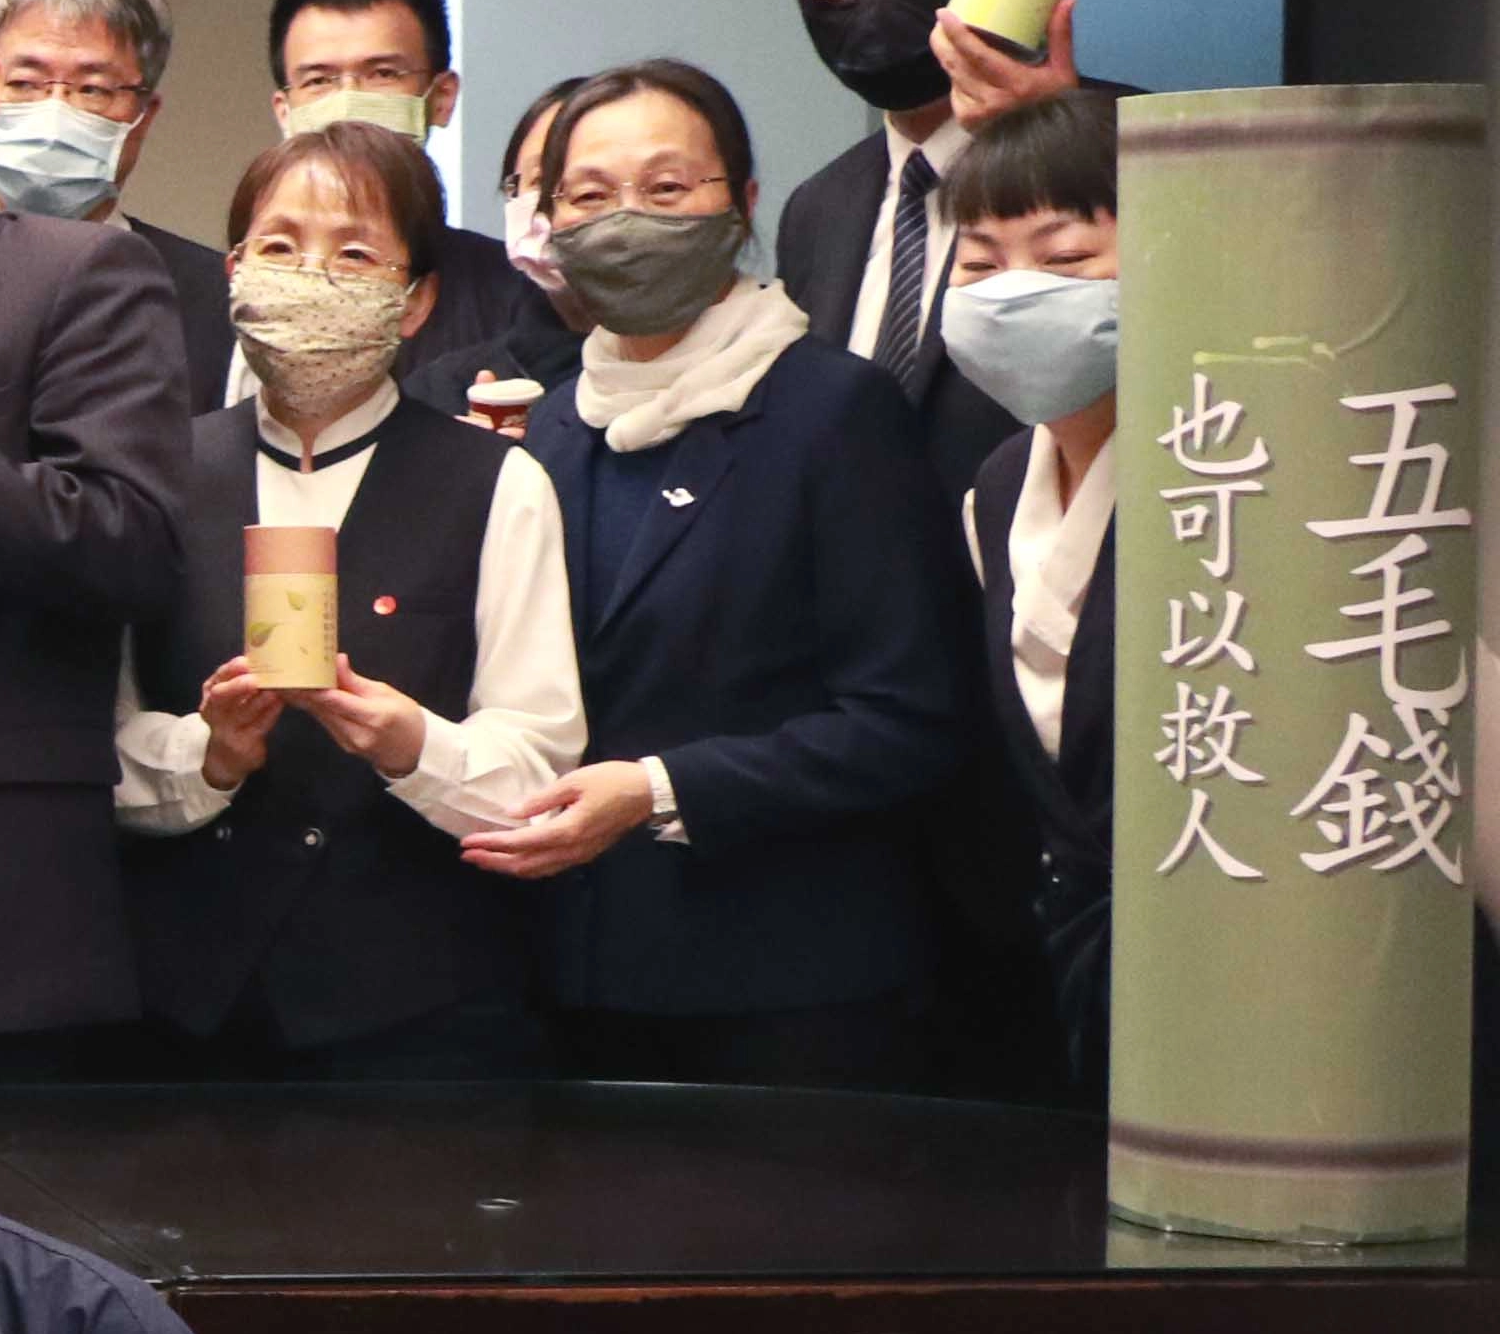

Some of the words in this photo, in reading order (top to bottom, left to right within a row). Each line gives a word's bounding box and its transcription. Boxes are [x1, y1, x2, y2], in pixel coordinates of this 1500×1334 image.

[1154, 372, 1270, 879] 也可以救人
[1289, 383, 1472, 886] 五毛錢
